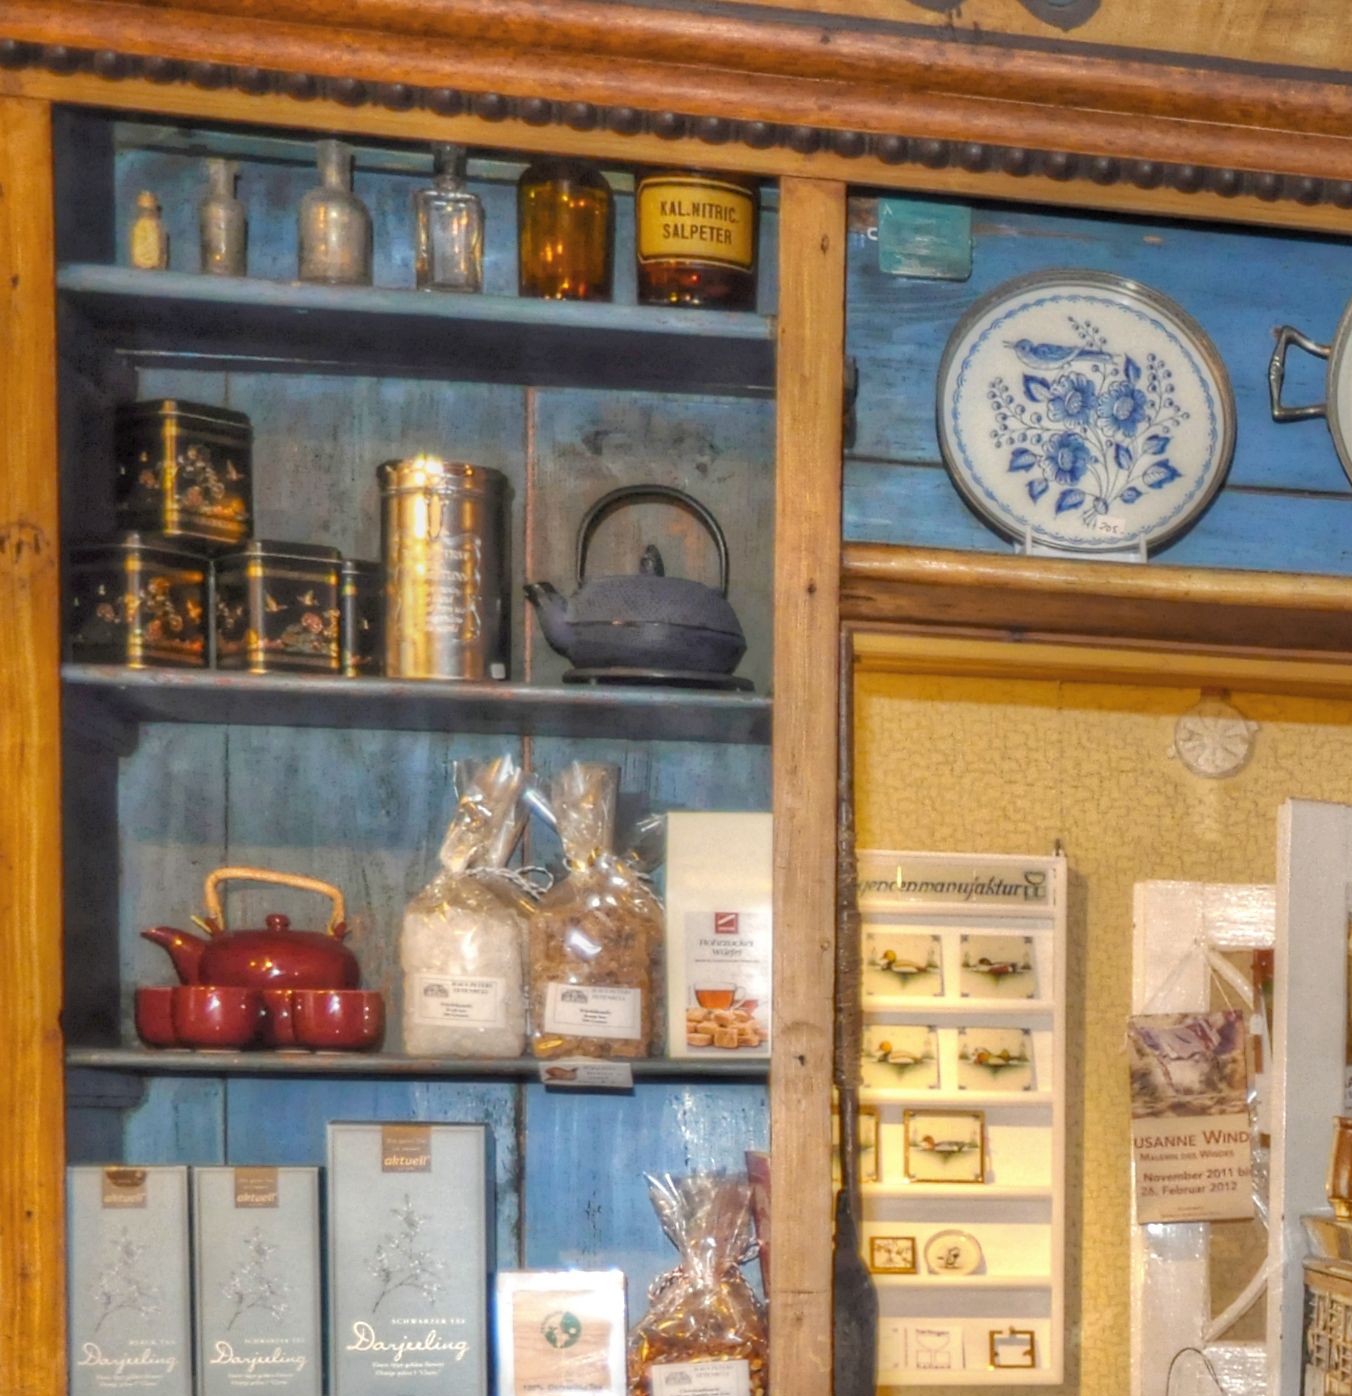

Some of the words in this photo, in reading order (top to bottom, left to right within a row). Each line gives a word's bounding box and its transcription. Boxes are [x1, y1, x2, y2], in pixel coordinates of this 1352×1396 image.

[662, 223, 733, 245] SALPETER
[1134, 1134, 1198, 1149] USANNE
[1143, 1170, 1203, 1182] November
[1207, 1168, 1233, 1179] 2011
[1162, 1185, 1205, 1195] Februar
[1209, 1181, 1238, 1192] 2012
[346, 1320, 471, 1361] Darjeeling
[77, 1342, 178, 1374] Darjeeling
[209, 1340, 308, 1372] Darjeeling
